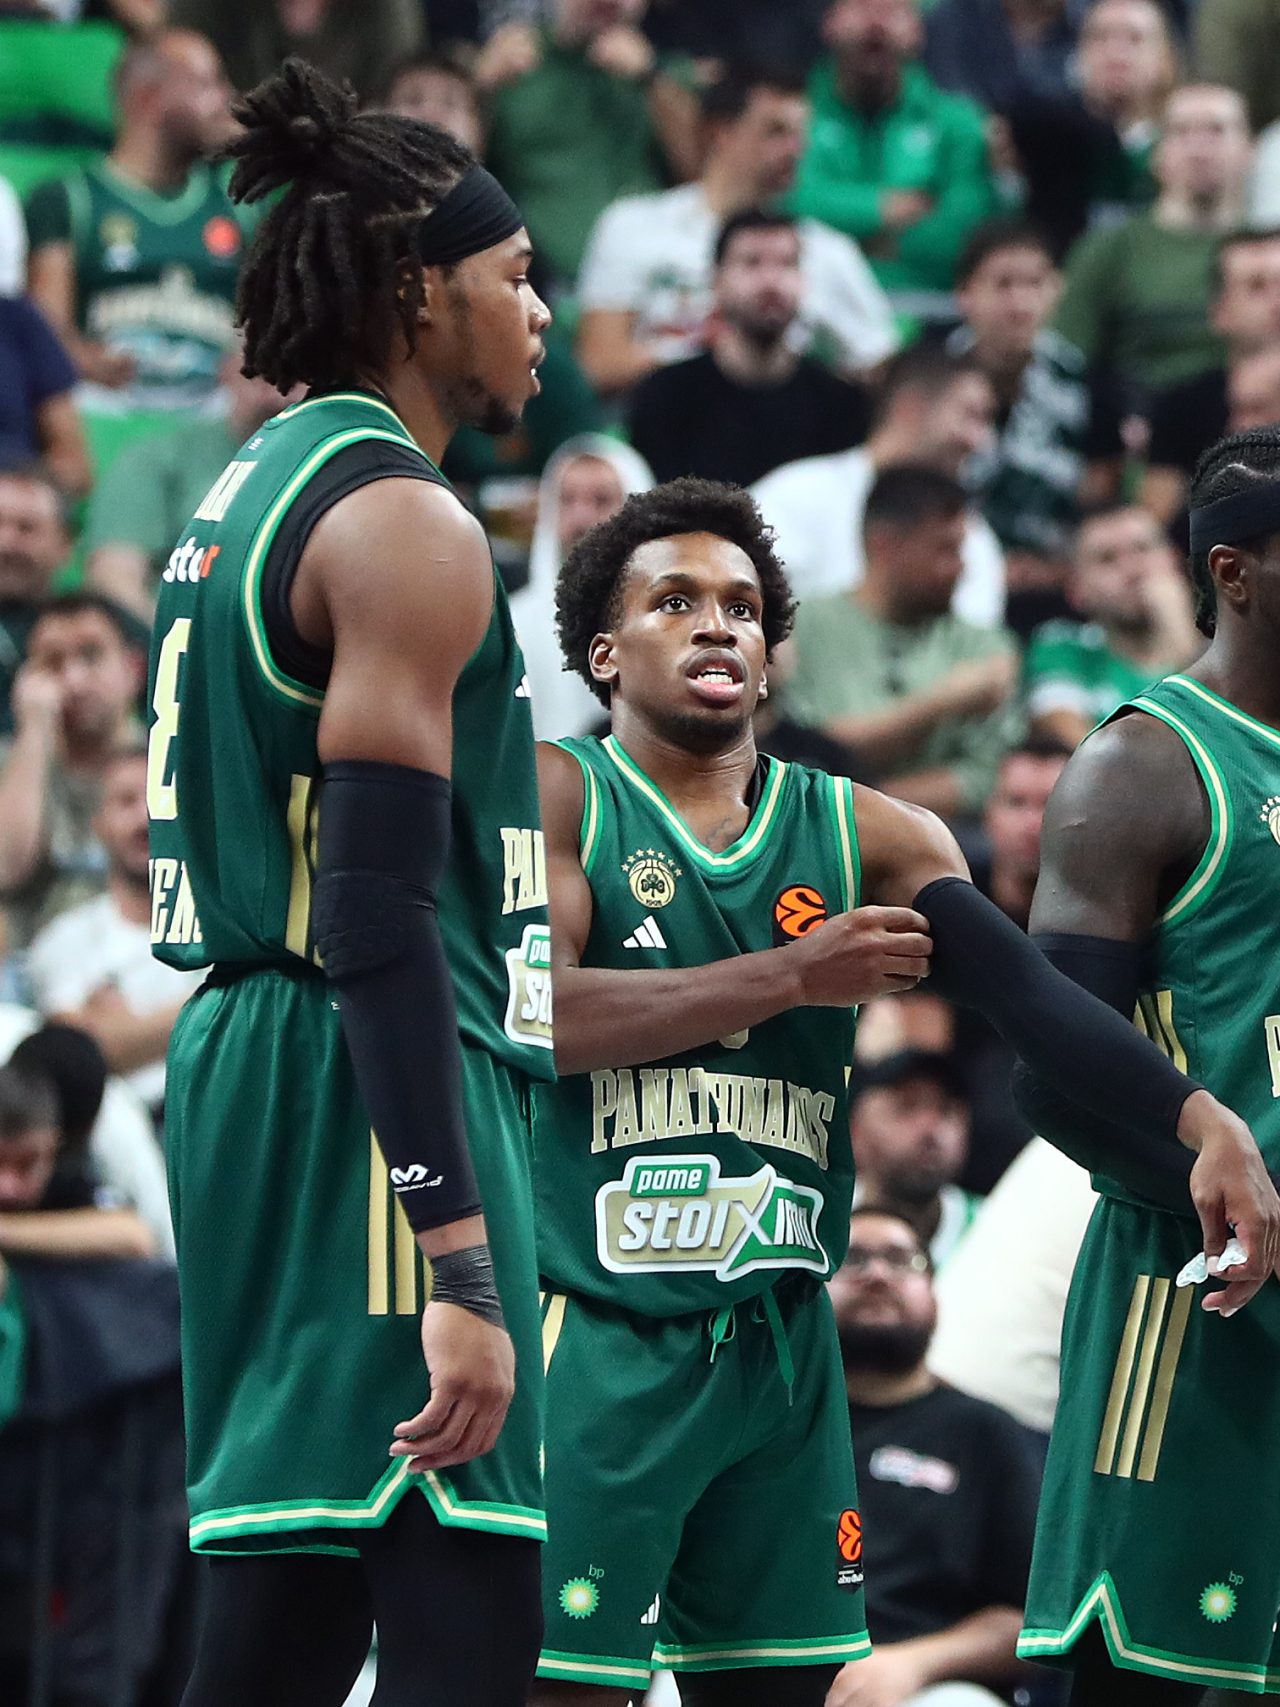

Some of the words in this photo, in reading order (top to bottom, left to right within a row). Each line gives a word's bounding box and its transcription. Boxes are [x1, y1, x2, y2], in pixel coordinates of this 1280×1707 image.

[636, 1168, 704, 1194] pame
[588, 1563, 605, 1580] bp
[1228, 1570, 1244, 1586] bp
